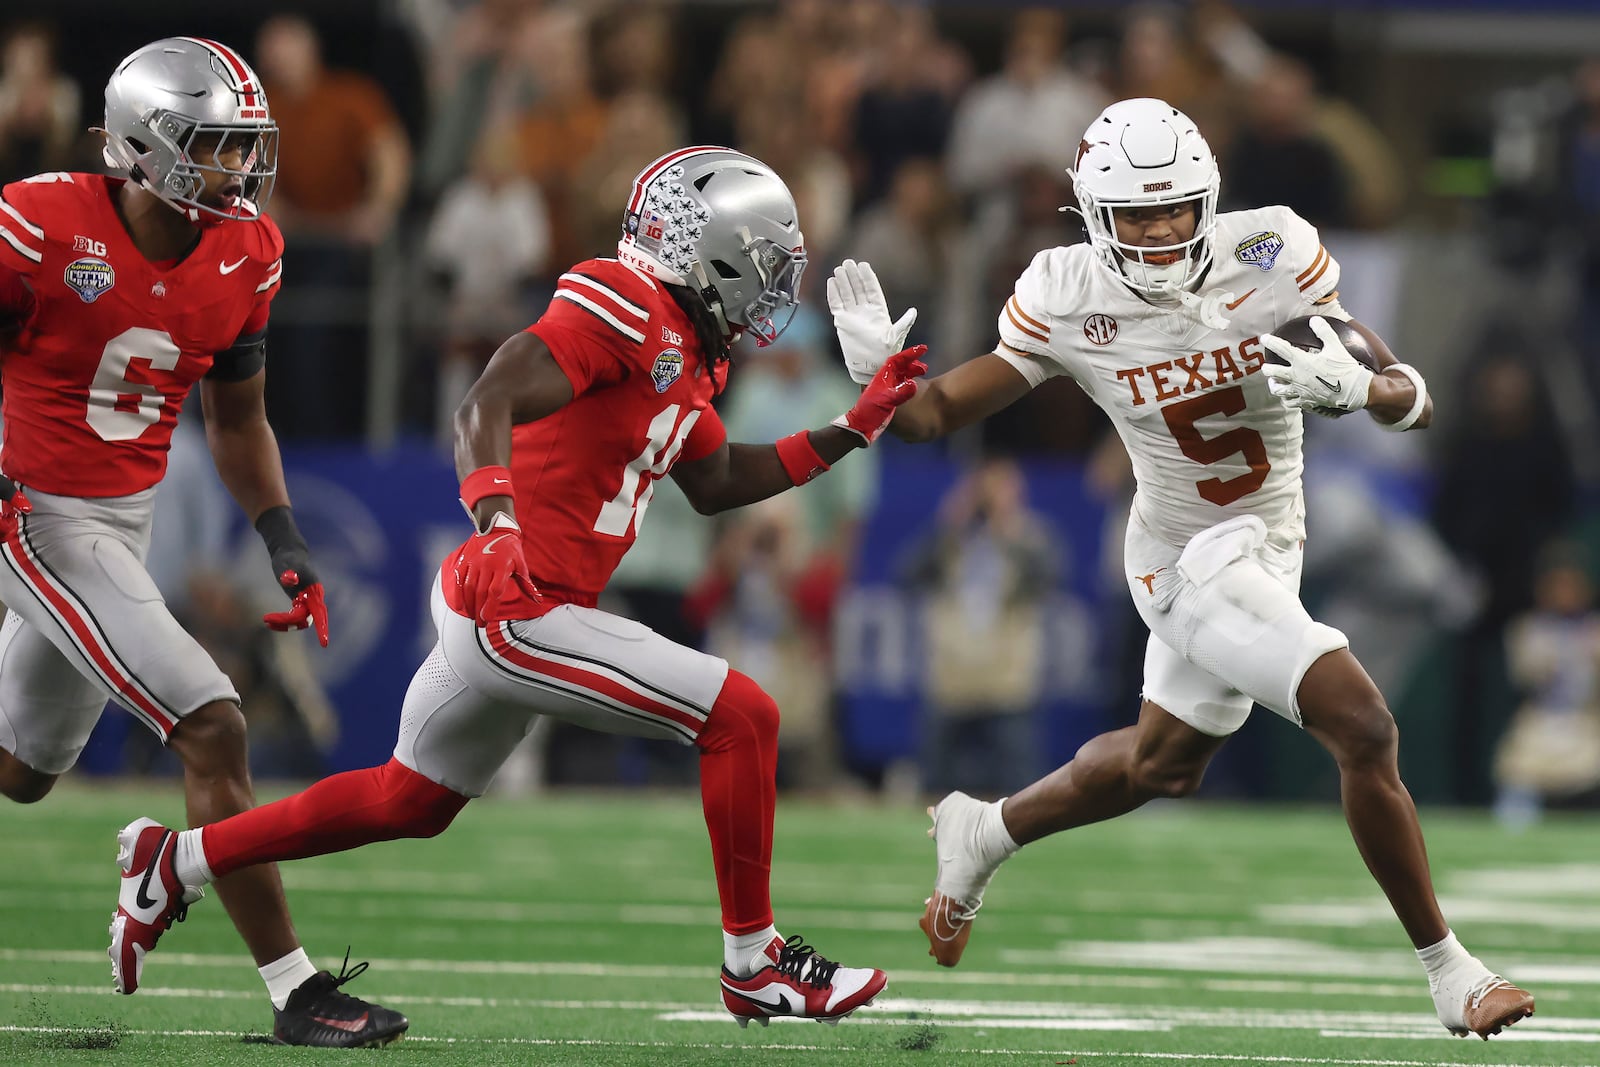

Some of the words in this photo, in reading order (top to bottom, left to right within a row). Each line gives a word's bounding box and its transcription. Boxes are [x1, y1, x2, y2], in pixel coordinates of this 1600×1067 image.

[1143, 181, 1173, 192] HORNS
[1239, 236, 1281, 260] COTTON
[70, 270, 111, 286] COTTON
[1085, 315, 1117, 344] SEC
[86, 326, 181, 441] 6
[1116, 336, 1266, 406] TEXAS
[1161, 385, 1271, 506] 5
